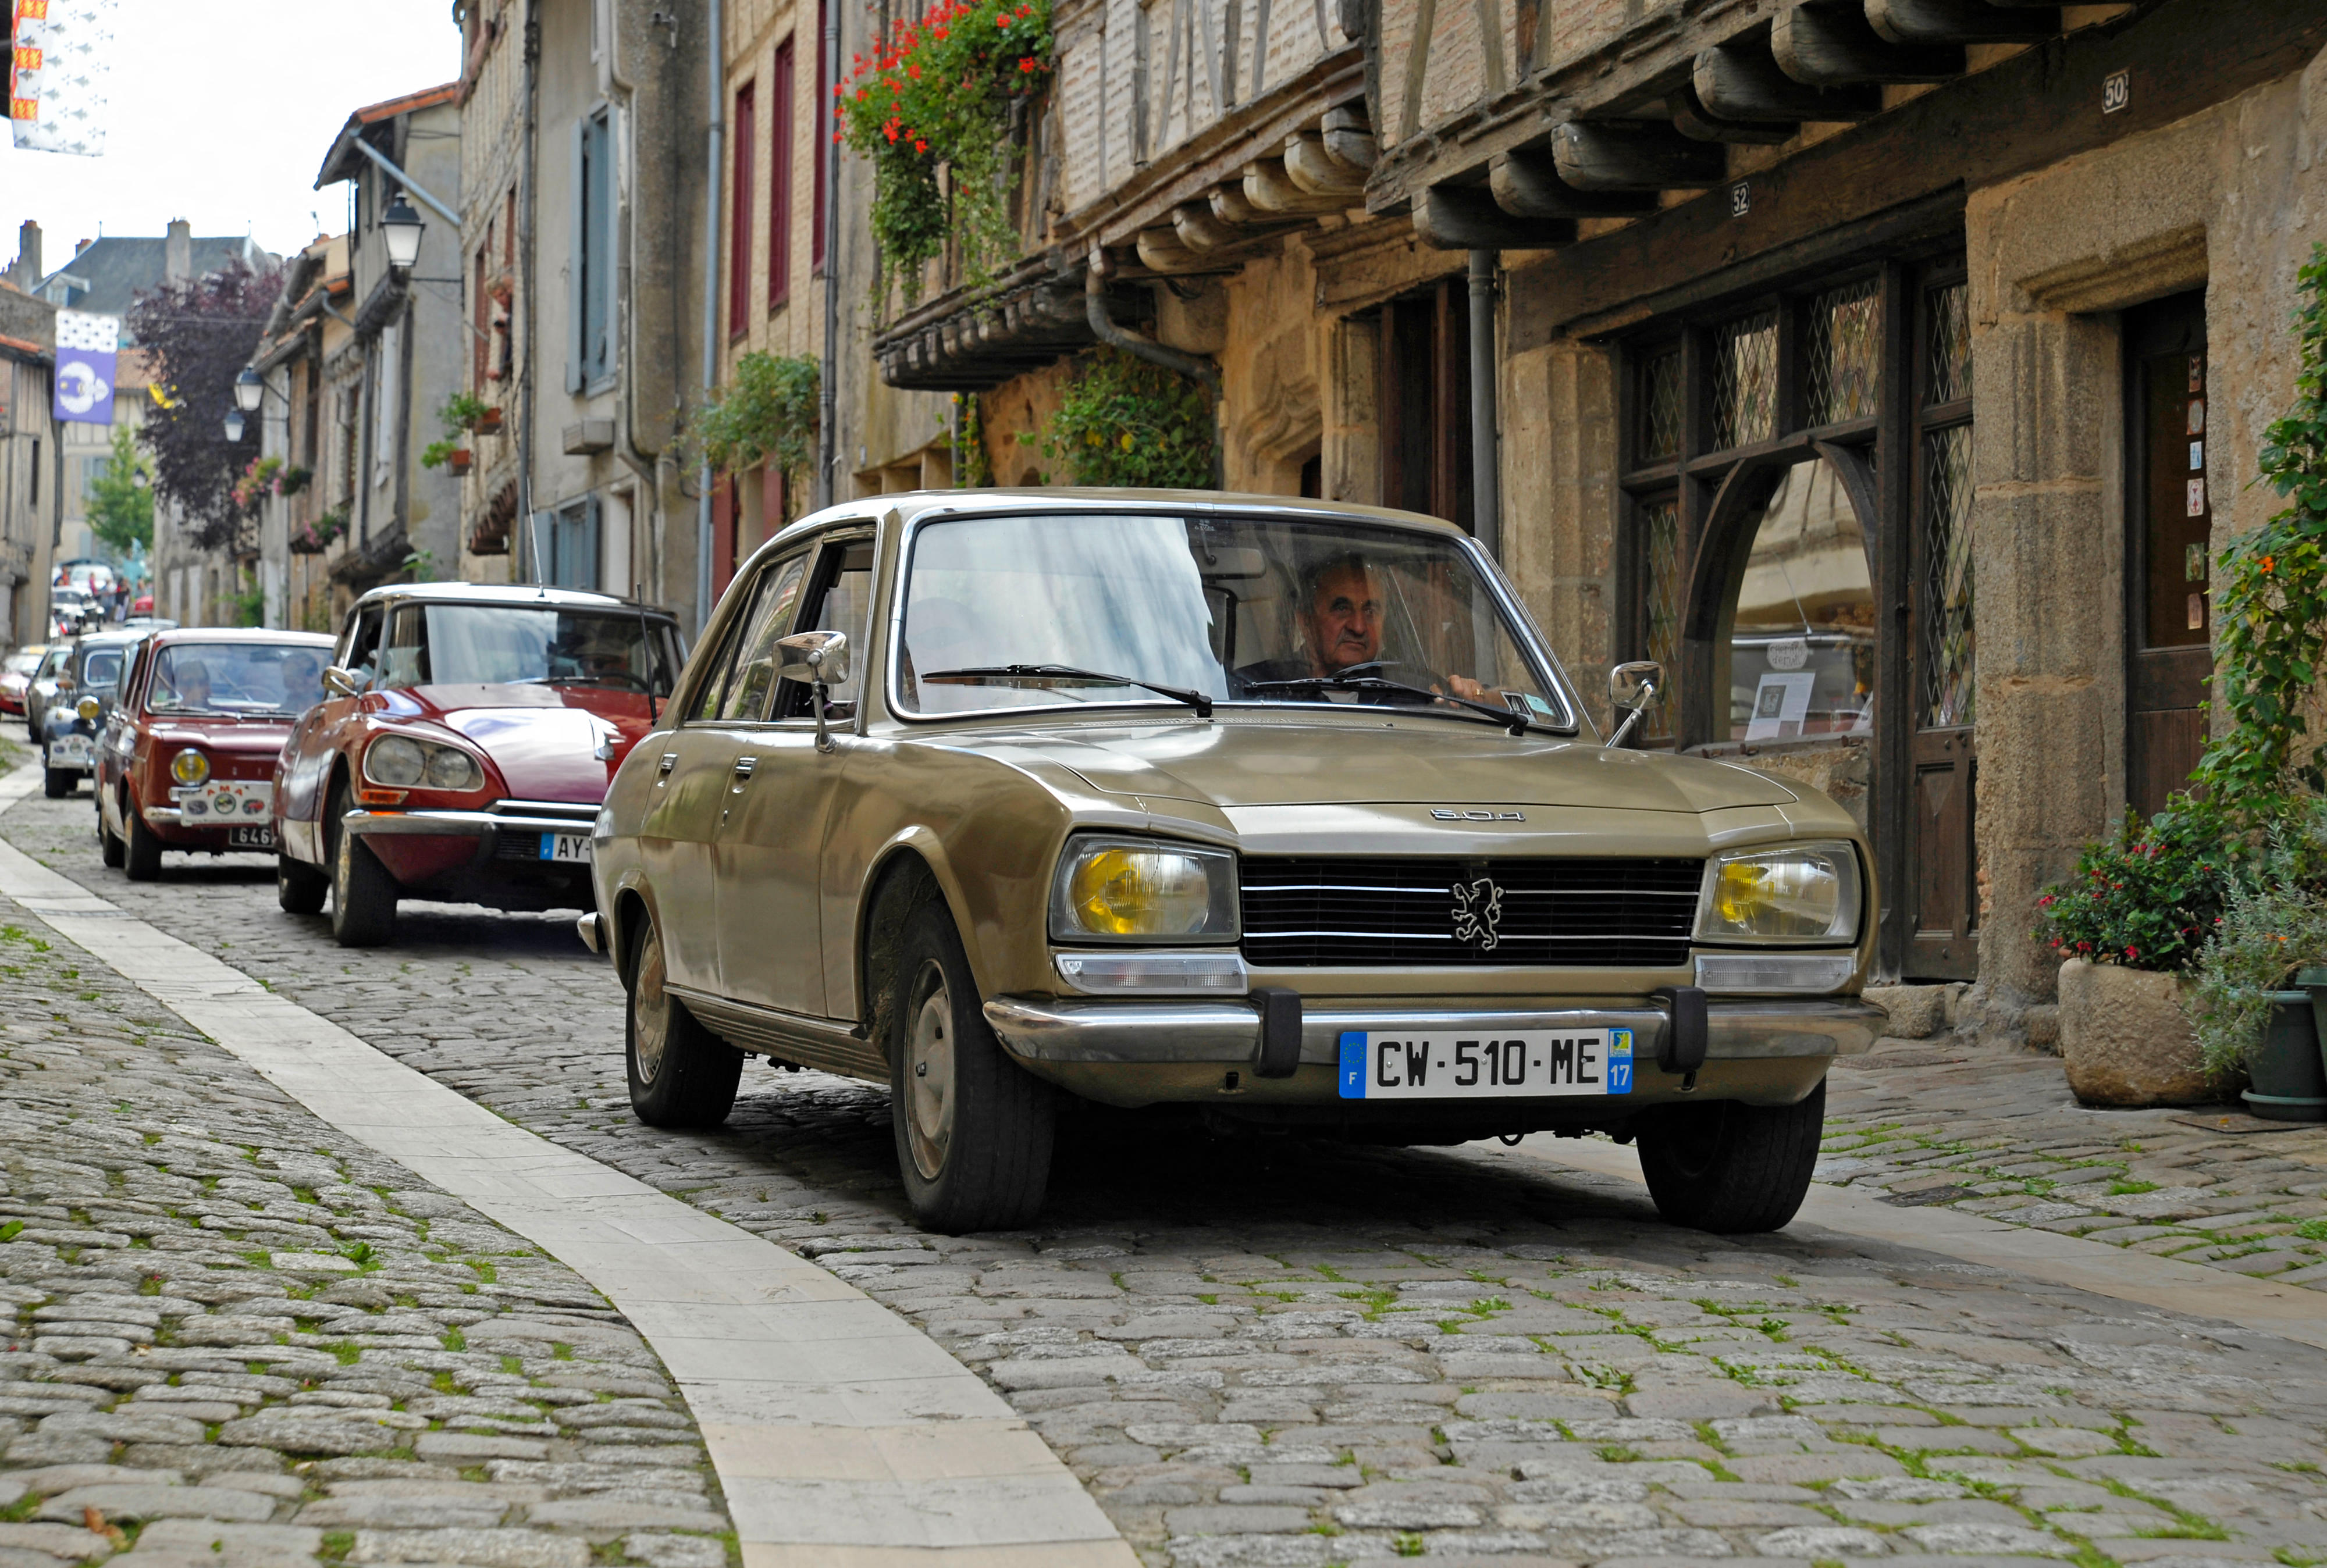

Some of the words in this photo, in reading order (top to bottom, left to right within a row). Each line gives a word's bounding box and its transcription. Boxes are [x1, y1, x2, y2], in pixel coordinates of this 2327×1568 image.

[2105, 77, 2124, 106] 50
[1734, 187, 1747, 211] 52
[207, 785, 243, 797] AMA
[239, 827, 270, 844] 646
[1348, 1072, 1357, 1085] F
[1377, 1038, 1600, 1087] CW-510-ME
[1610, 1064, 1630, 1086] 17
